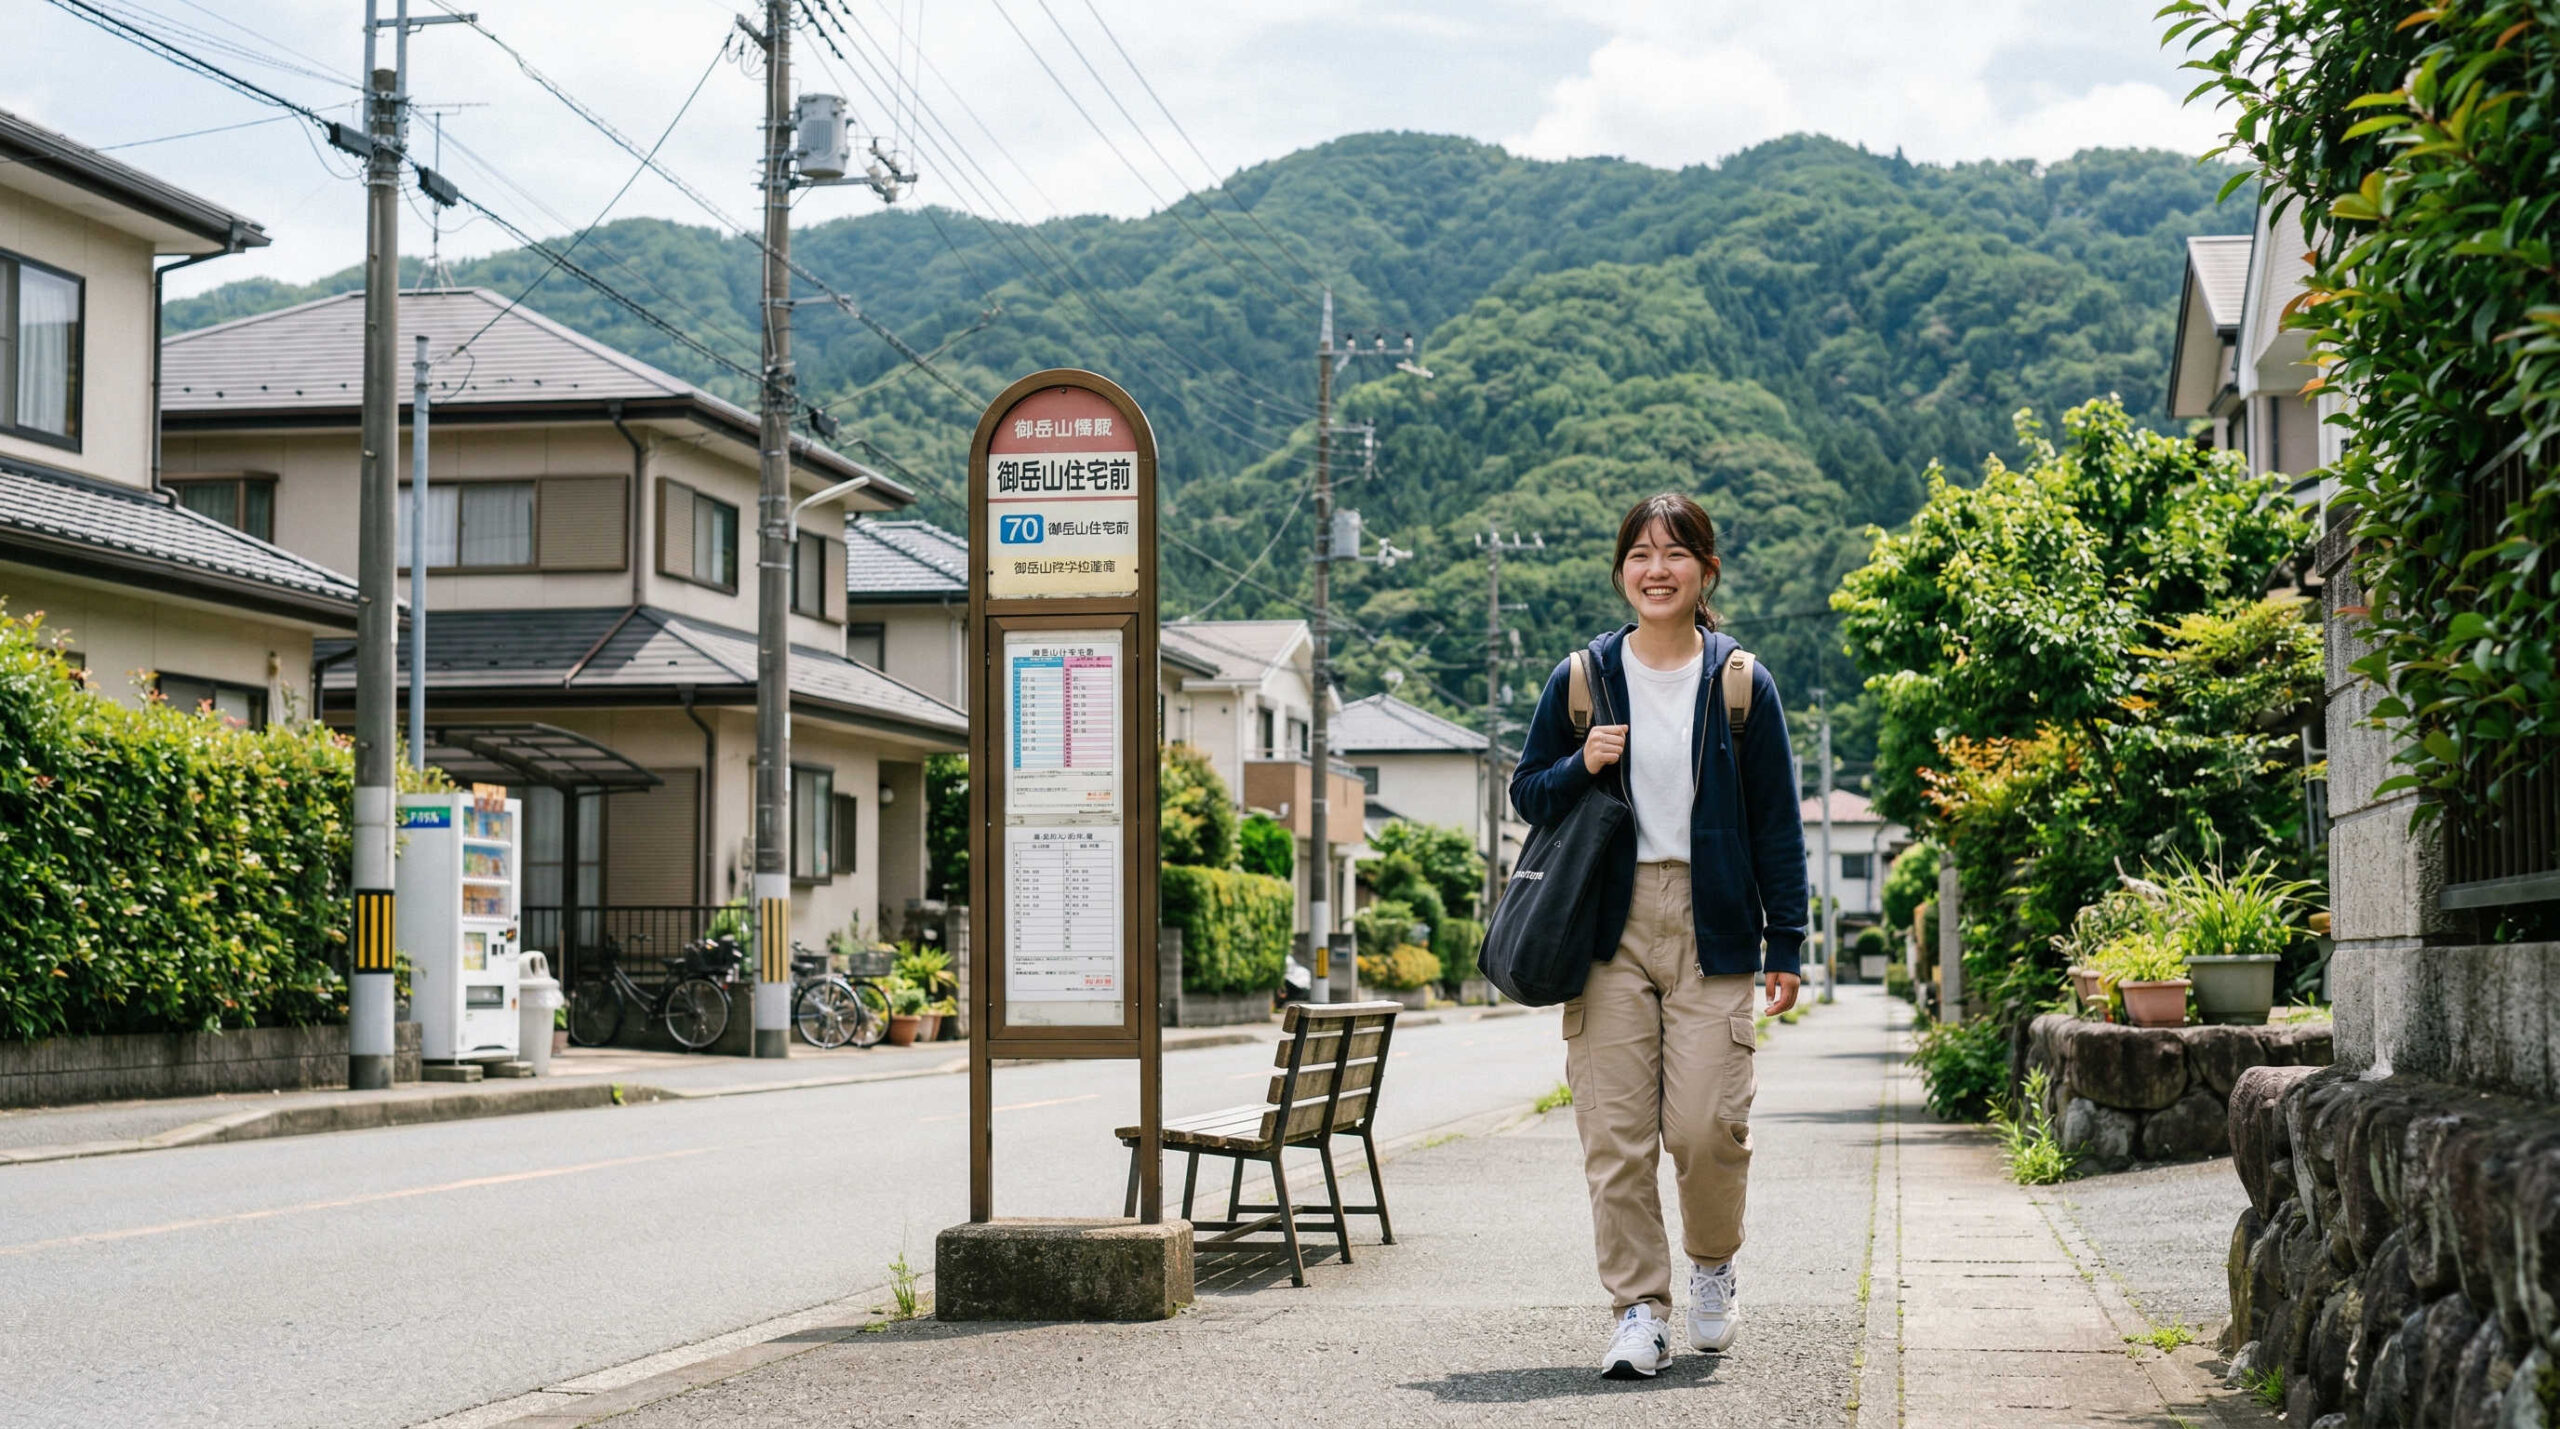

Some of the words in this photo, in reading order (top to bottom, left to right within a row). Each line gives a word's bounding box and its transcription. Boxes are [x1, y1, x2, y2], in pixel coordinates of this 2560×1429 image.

[997, 458, 1131, 493] 御岳山住宅前
[1005, 517, 1039, 541] 70
